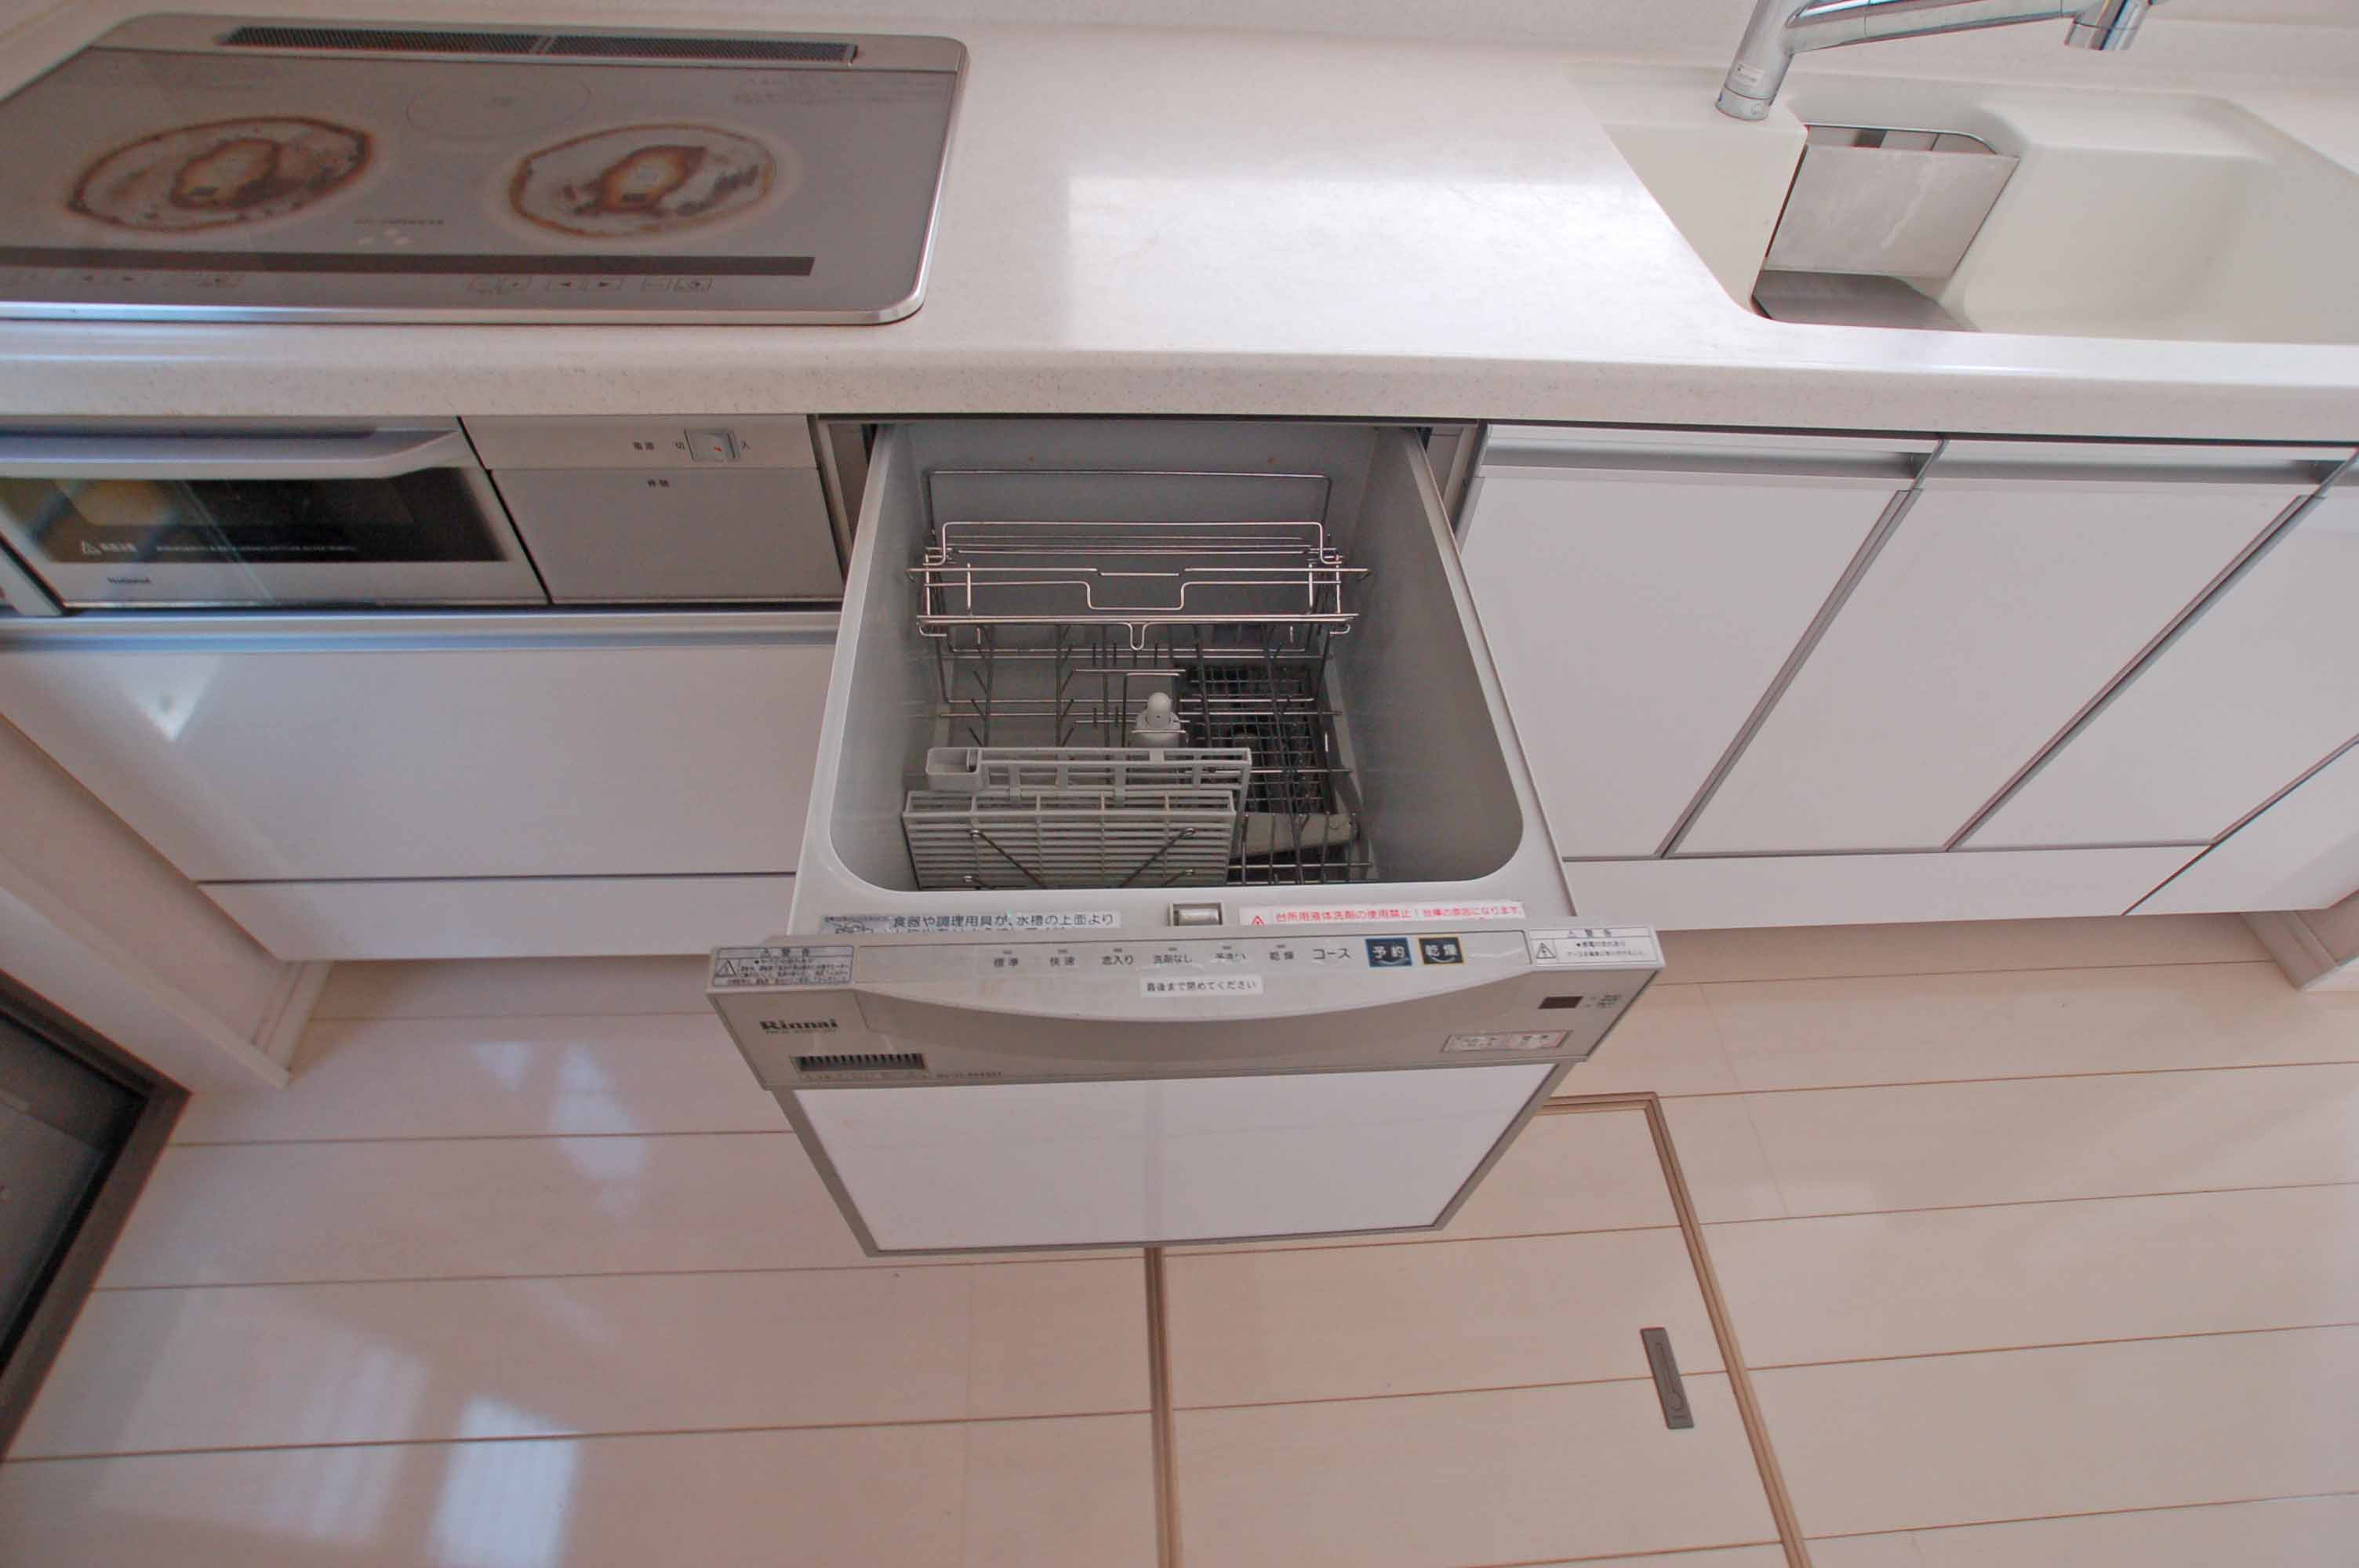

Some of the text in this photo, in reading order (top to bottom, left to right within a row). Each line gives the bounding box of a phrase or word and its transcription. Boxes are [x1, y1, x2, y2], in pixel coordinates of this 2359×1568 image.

[1313, 947, 1350, 960] コース
[1373, 945, 1405, 959] 予約
[1425, 943, 1458, 956] 乾燥
[758, 1018, 839, 1030] Rinnai
